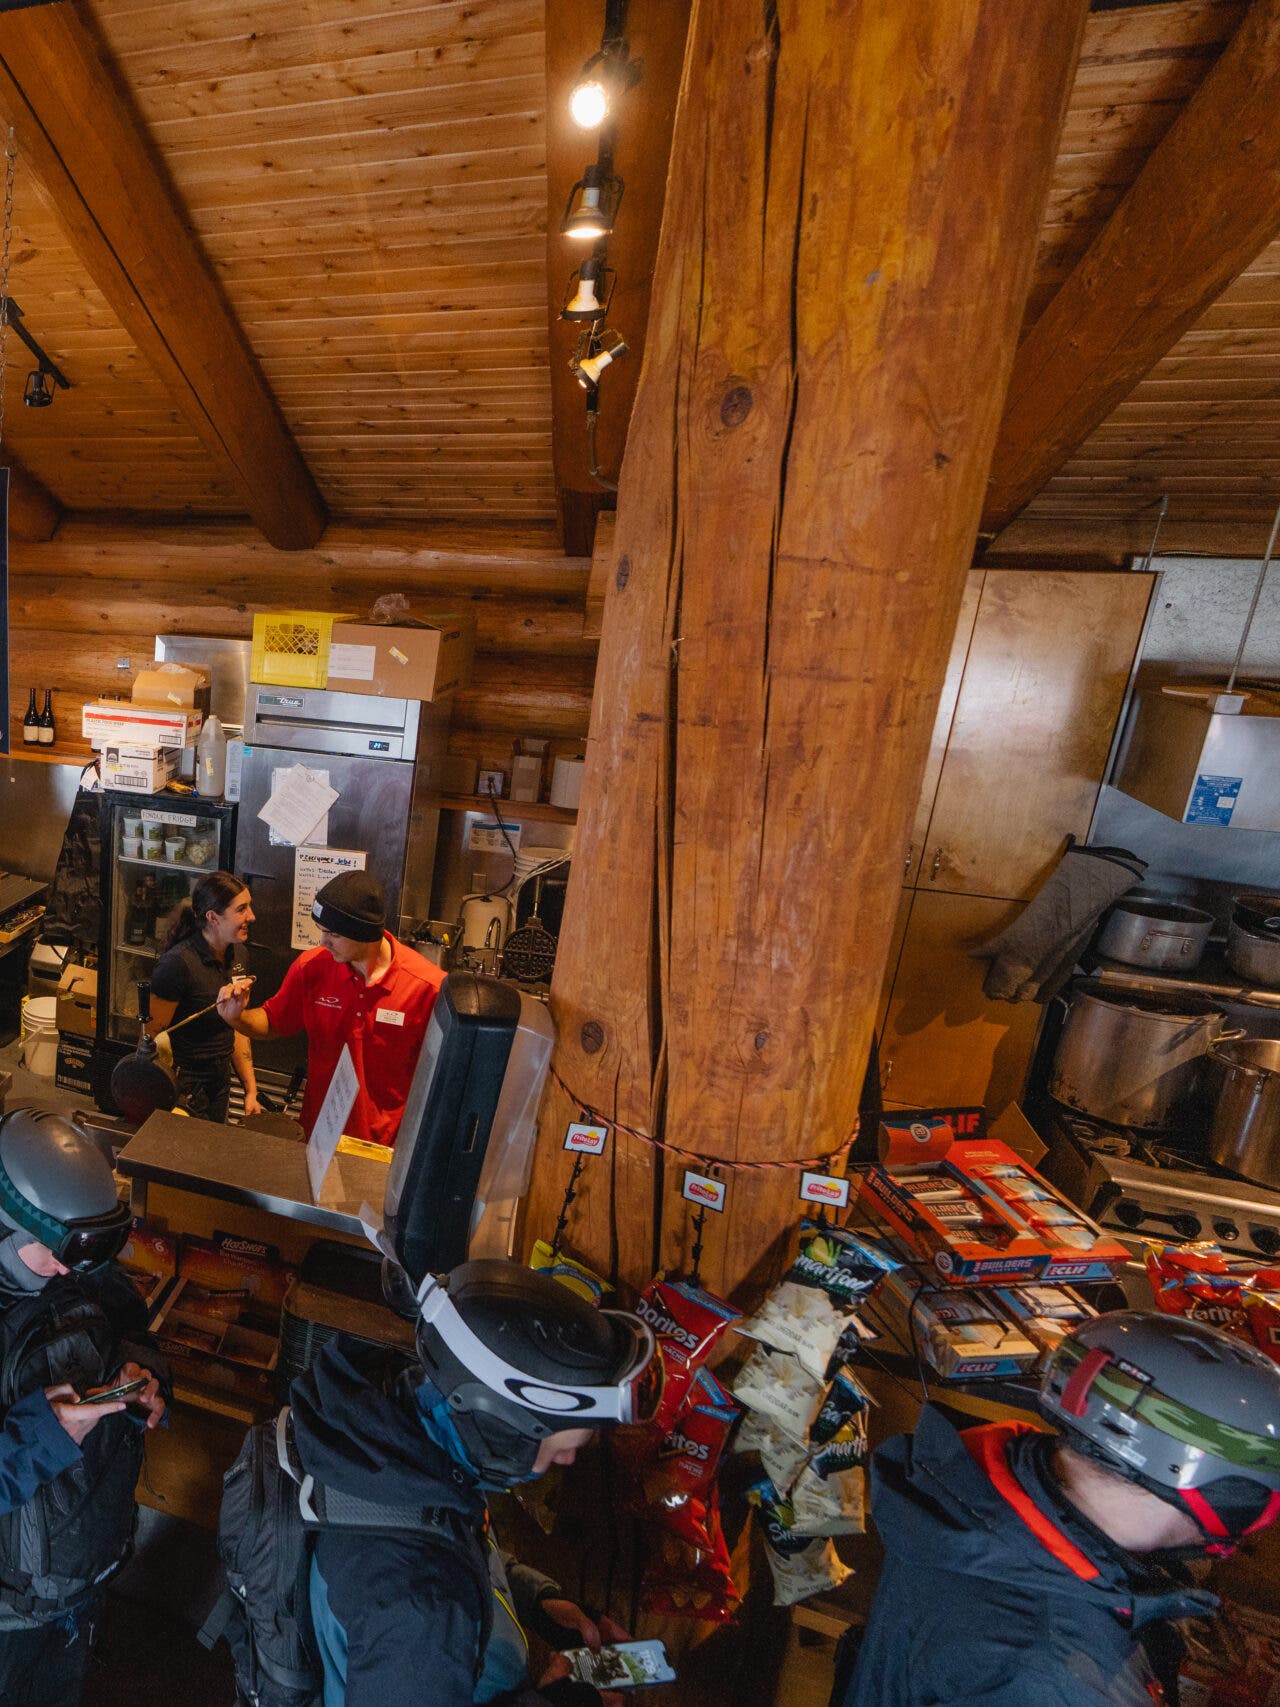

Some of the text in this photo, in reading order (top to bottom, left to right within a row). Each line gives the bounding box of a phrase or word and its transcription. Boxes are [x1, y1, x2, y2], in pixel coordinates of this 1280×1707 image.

[168, 814, 194, 824] FRIDGE
[154, 1241, 165, 1253] 6
[980, 1259, 1034, 1271] BUILDERS
[1056, 1266, 1088, 1275] CLIF
[793, 1253, 875, 1292] martfood
[635, 1298, 700, 1350] Doritos
[967, 1363, 998, 1373] CLIF
